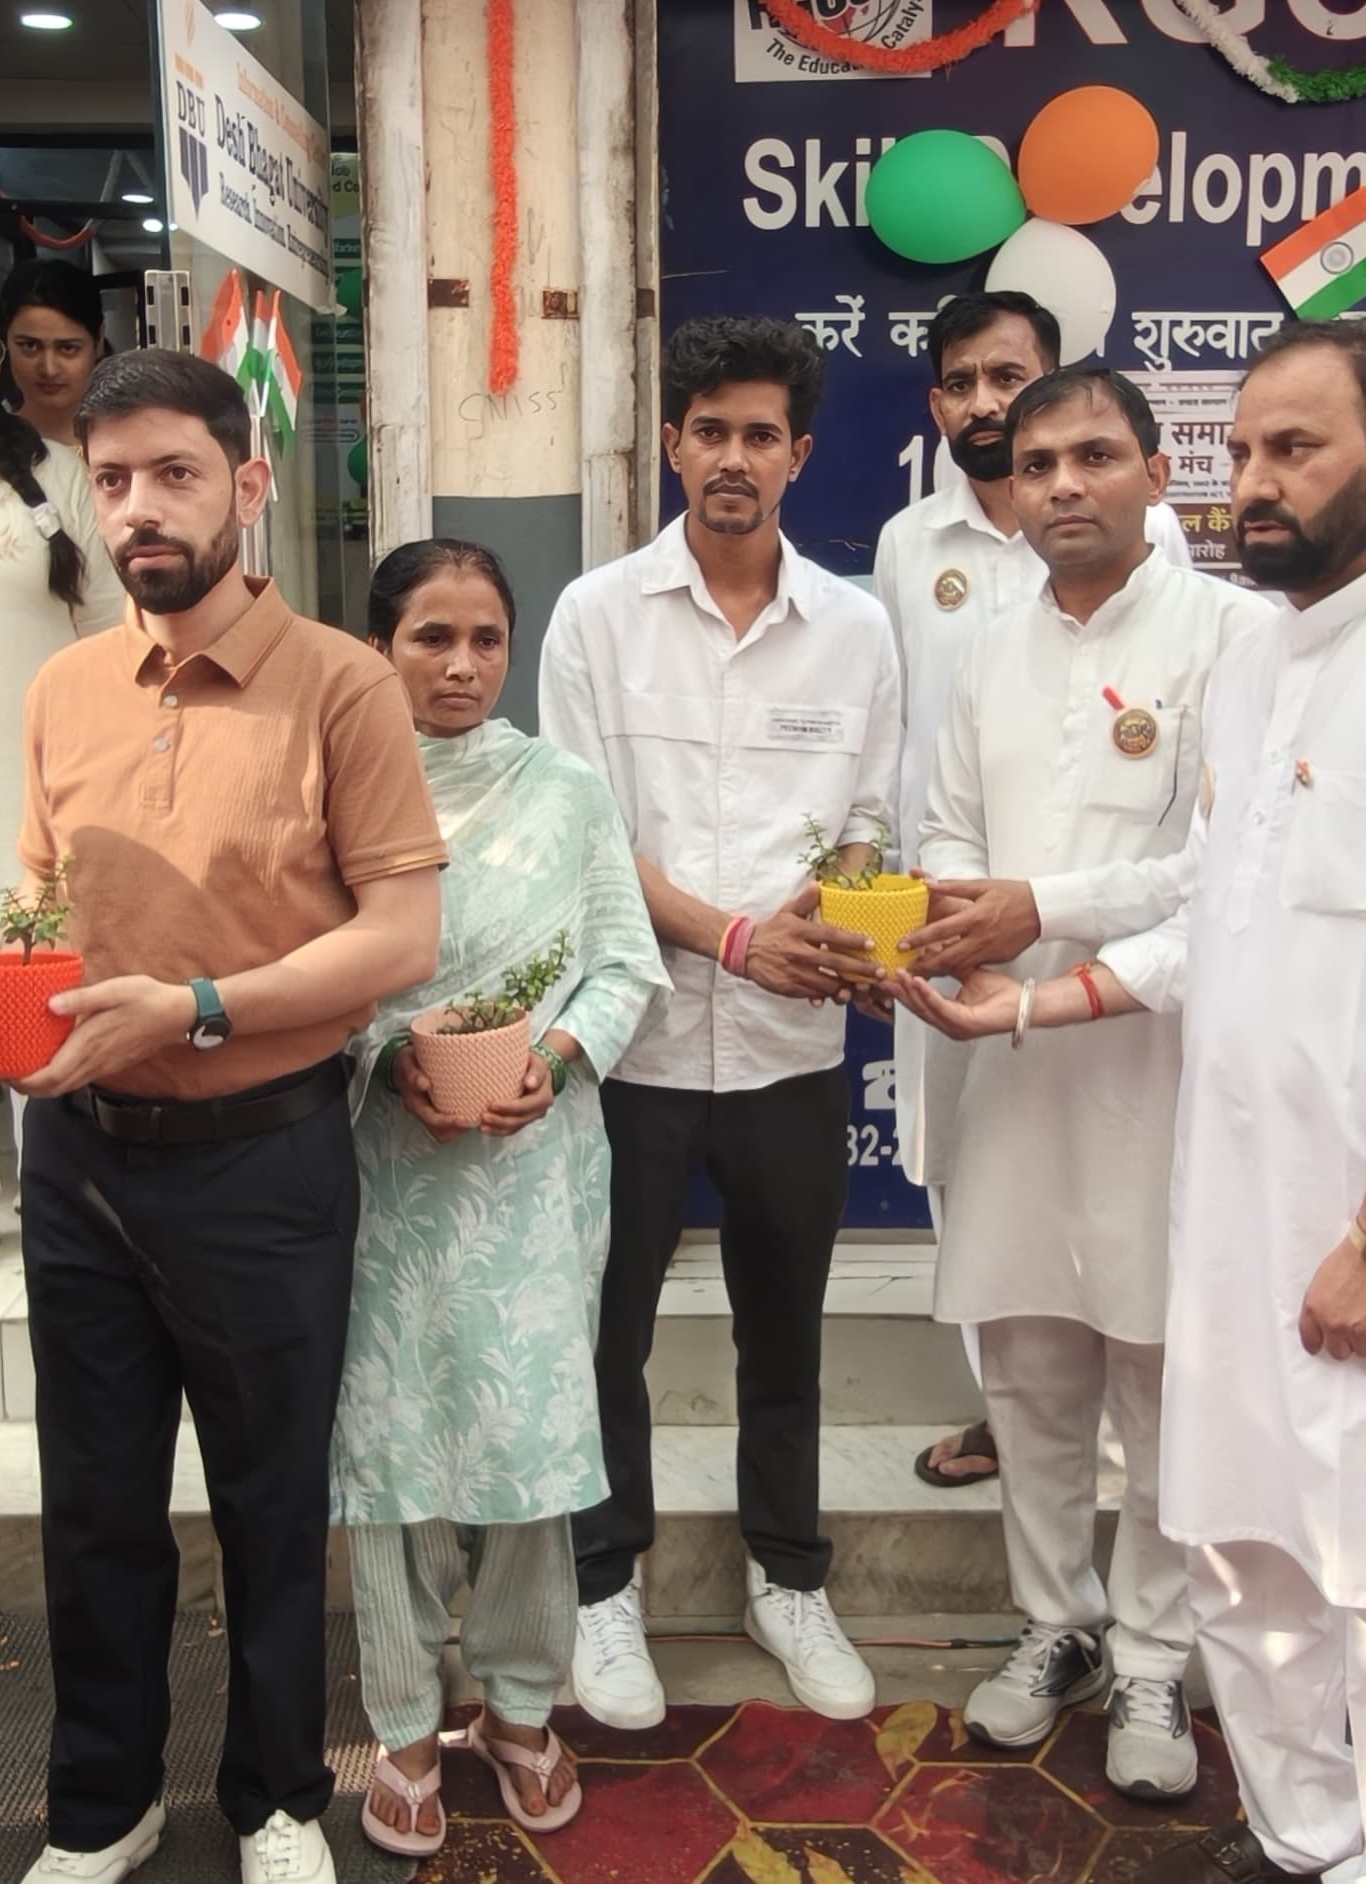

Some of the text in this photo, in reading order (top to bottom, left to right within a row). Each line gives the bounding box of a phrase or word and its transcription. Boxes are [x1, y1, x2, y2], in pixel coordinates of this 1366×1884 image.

[766, 38, 796, 66] The
[176, 80, 206, 138] DBU
[215, 95, 246, 168] Desh
[247, 120, 285, 207] Bhagat
[1171, 422, 1234, 445] समा
[1177, 450, 1214, 475] मंच
